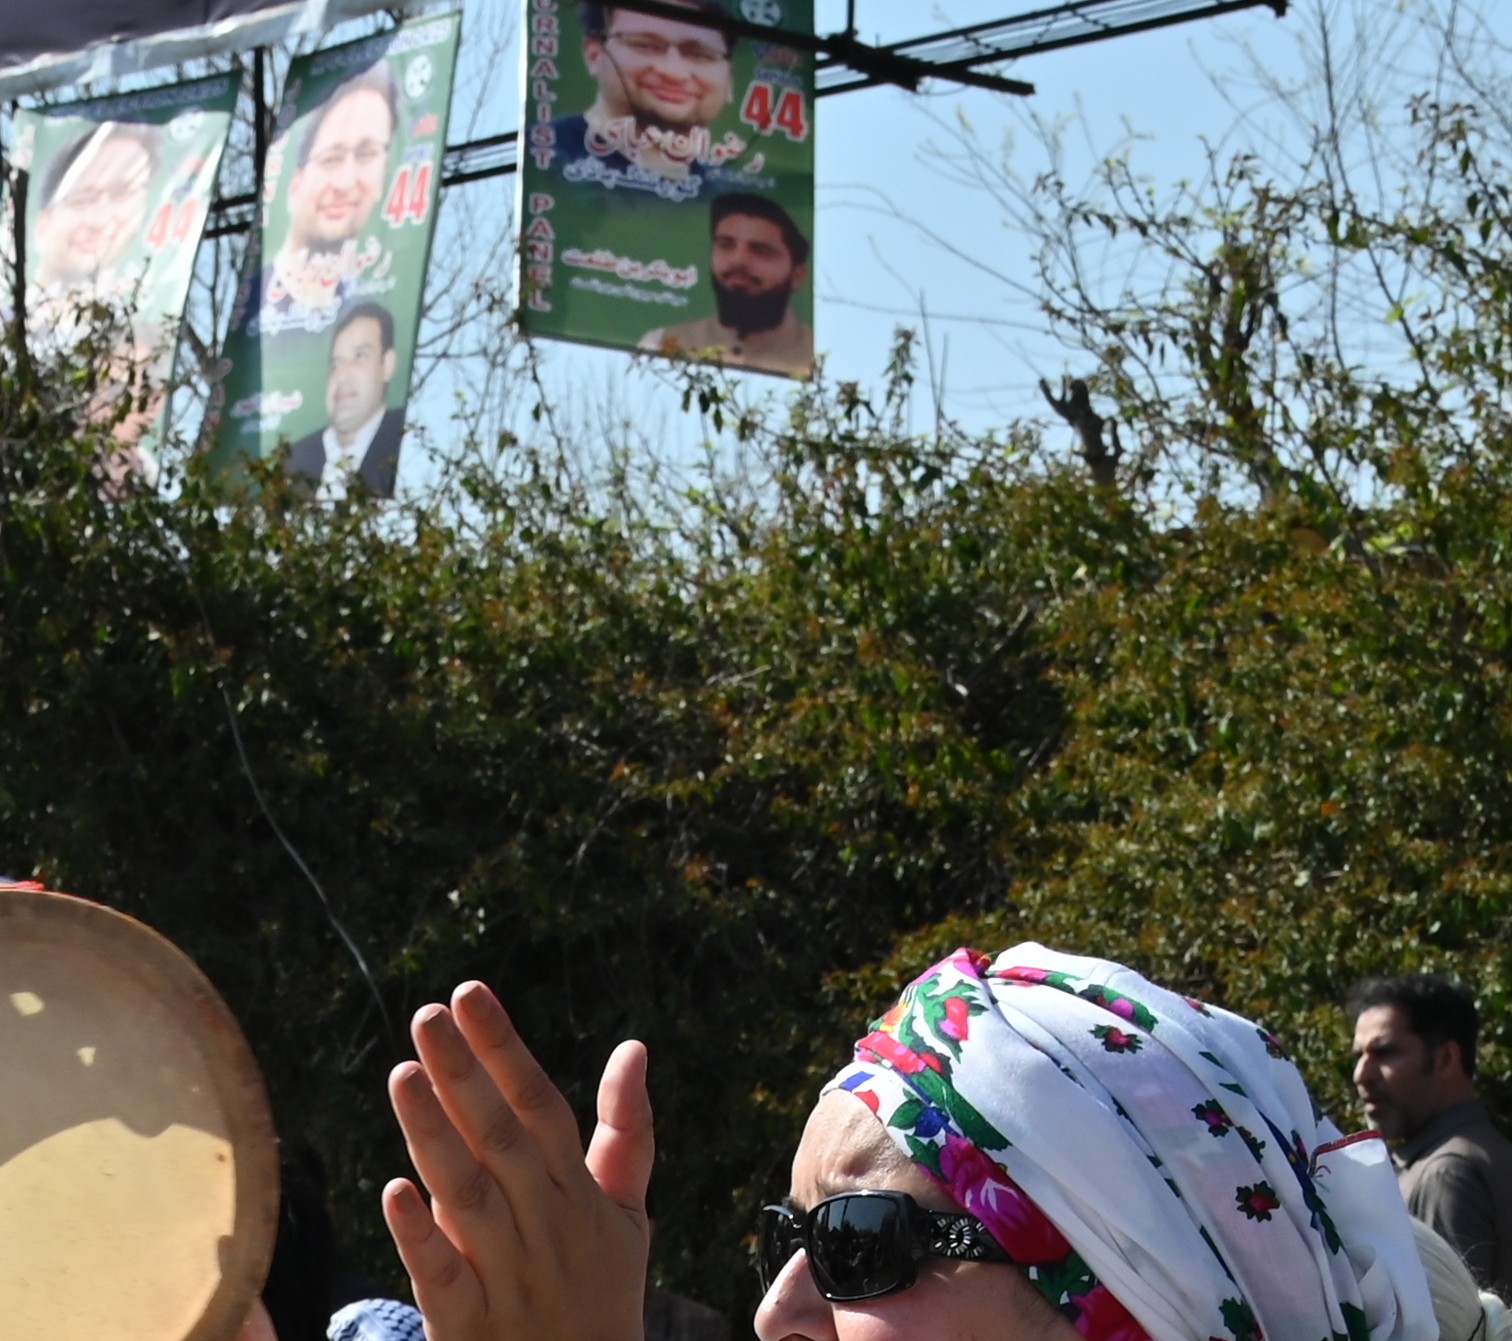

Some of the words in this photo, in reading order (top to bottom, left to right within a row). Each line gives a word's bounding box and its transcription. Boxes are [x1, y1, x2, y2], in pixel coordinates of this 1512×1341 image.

[741, 81, 808, 141] 44
[146, 197, 199, 249] 44
[383, 163, 432, 227] 44
